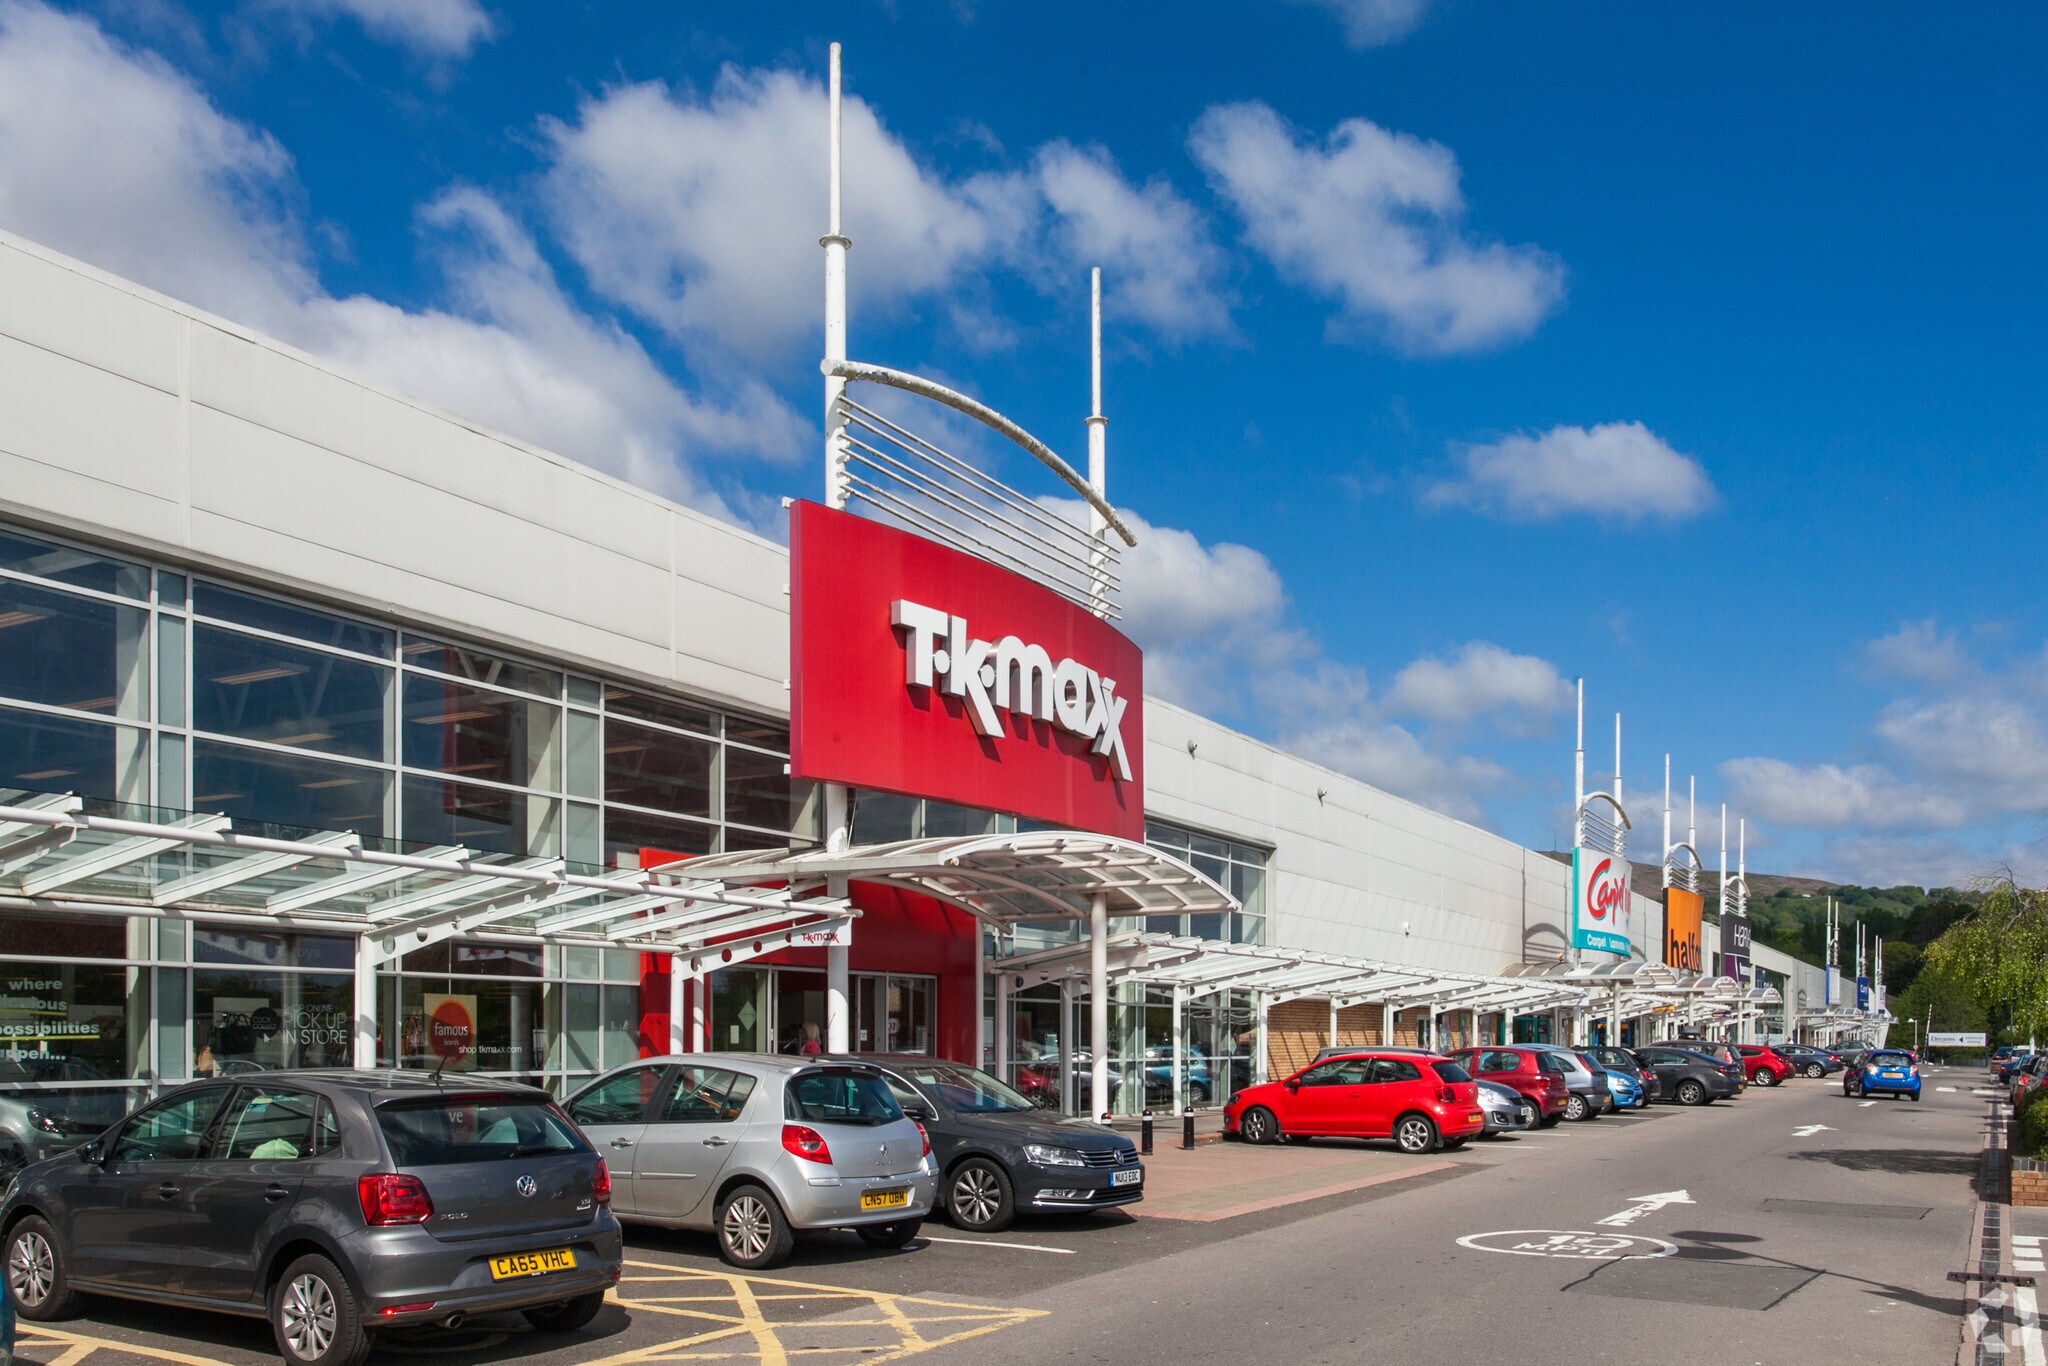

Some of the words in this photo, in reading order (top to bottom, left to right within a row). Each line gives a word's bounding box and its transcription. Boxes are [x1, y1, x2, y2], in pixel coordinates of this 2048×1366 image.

[9, 978, 63, 990] where
[306, 1004, 333, 1013] ONLINE
[283, 1012, 320, 1029] PICK
[326, 1013, 347, 1029] UP
[434, 1022, 469, 1036] famous
[283, 1030, 297, 1045] IN
[300, 1030, 348, 1045] STORE
[459, 1045, 477, 1054] shop
[864, 1193, 887, 1206] CN57
[440, 1212, 469, 1220] POLO
[1512, 1242, 1614, 1255] MPH
[496, 1255, 539, 1276] CA65
[540, 1250, 570, 1270] VHC
